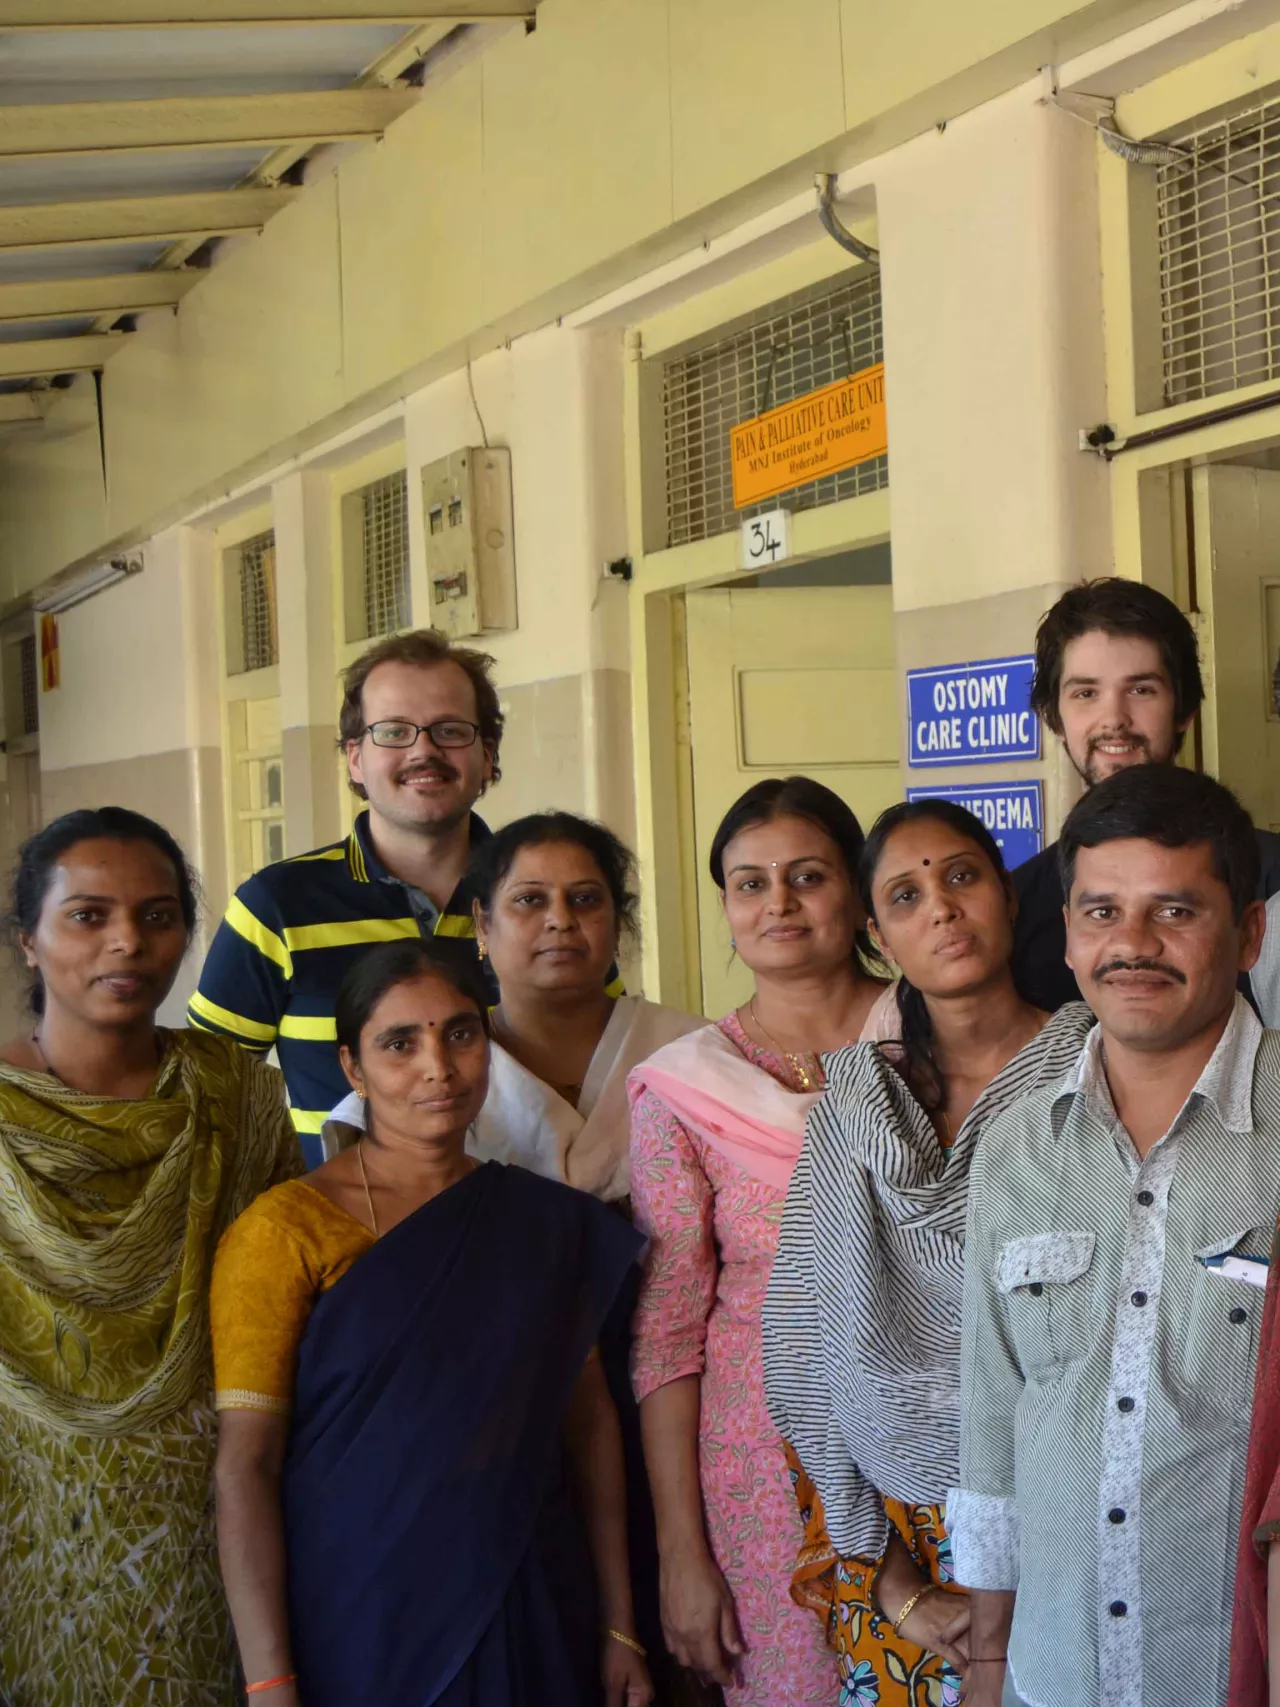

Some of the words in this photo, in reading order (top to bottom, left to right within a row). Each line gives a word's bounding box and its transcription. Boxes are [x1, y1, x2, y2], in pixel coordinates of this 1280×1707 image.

[735, 429, 757, 462] PAIN
[759, 426, 766, 452] &
[767, 401, 826, 448] PALLIATIVE
[828, 387, 856, 423] CARE
[858, 374, 884, 411] UNIT
[749, 453, 770, 473] MNJ
[772, 440, 812, 465] Institute
[814, 431, 825, 447] of
[827, 416, 872, 442] Oncology
[749, 520, 781, 561] 34
[933, 674, 1008, 713] OSTOMY
[917, 717, 962, 752] CARE
[968, 711, 1029, 748] CLINIC
[951, 797, 1033, 830] EDEMA
